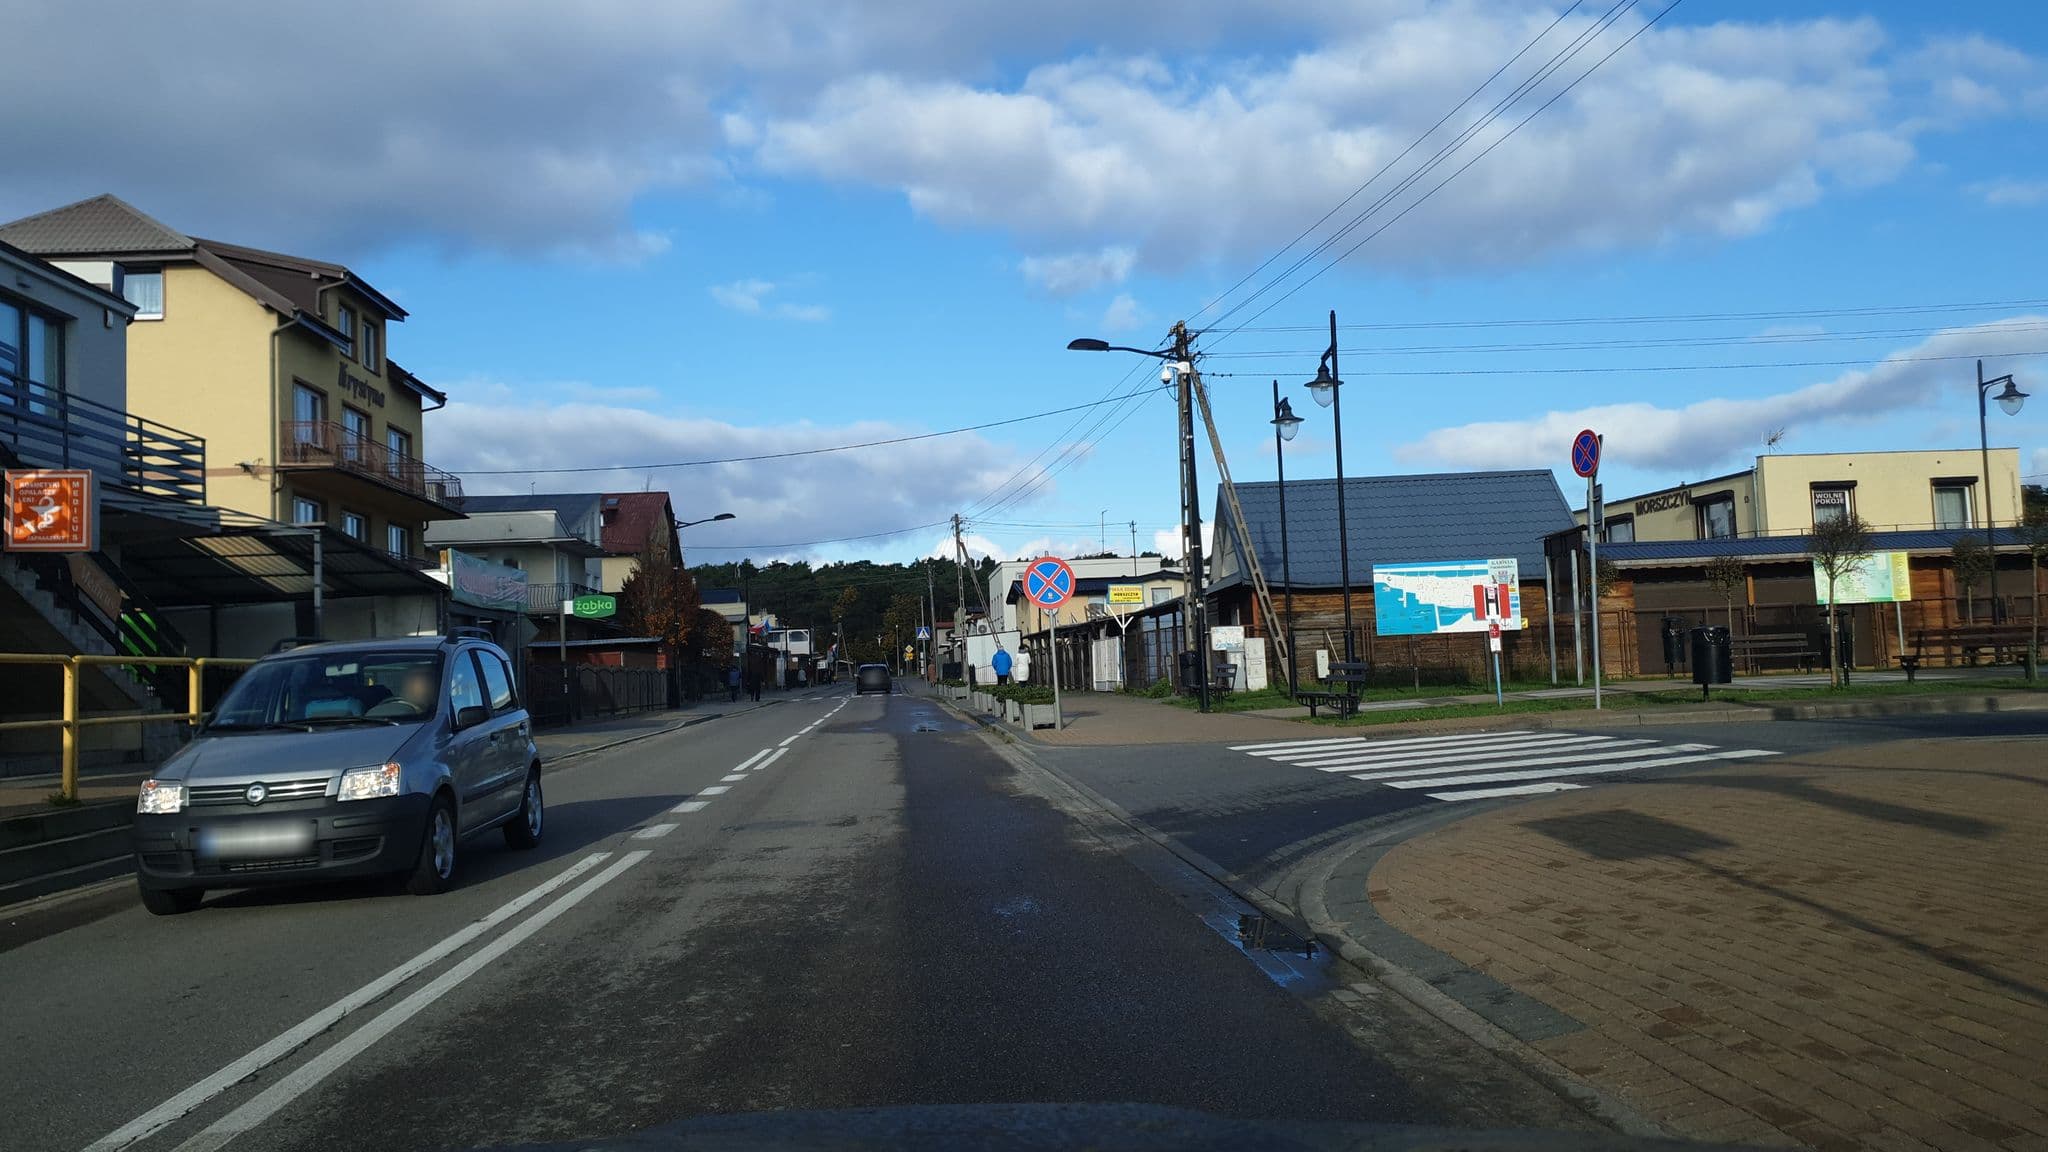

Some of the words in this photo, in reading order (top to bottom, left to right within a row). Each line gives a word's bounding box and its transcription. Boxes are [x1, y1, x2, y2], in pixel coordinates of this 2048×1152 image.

[338, 361, 385, 408] Krystyna
[72, 481, 80, 541] MEDICUS
[1635, 490, 1691, 516] MORSZCZYN
[575, 600, 613, 610] żabka
